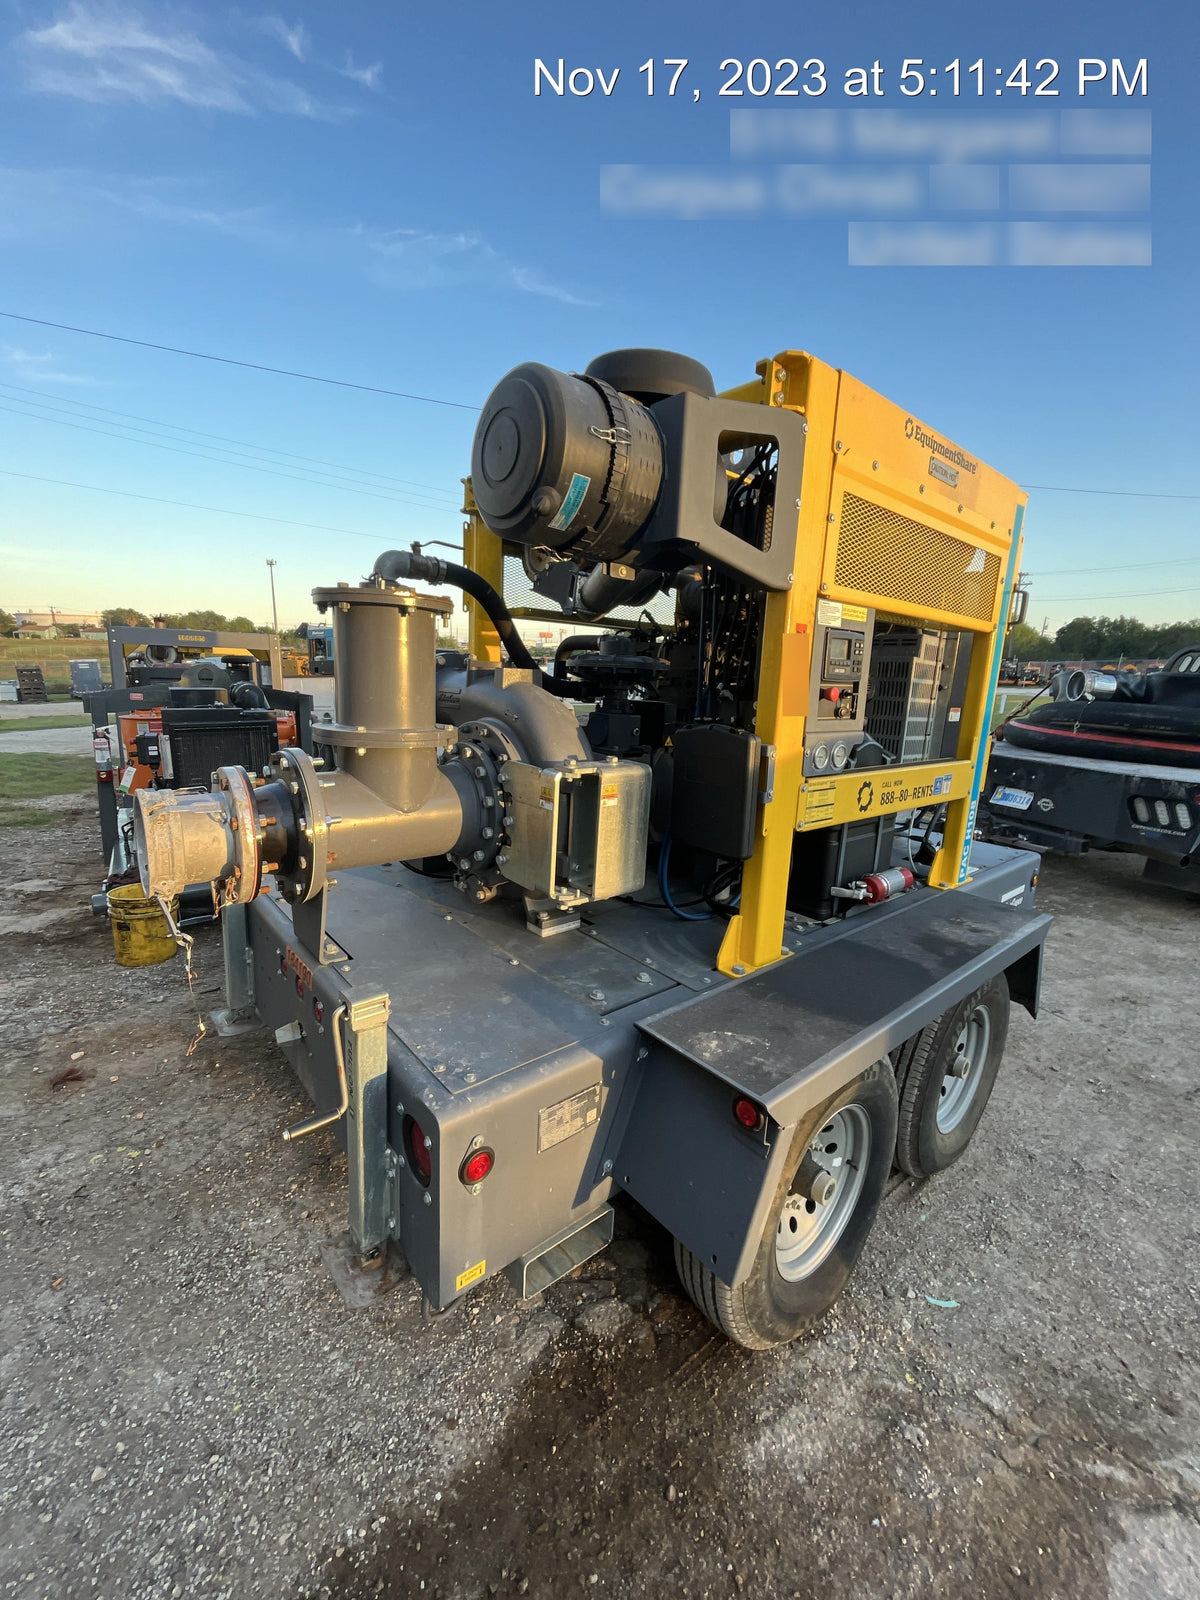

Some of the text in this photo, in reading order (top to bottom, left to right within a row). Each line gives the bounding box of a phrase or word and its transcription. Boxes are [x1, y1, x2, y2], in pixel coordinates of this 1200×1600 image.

[914, 425, 977, 474] EquipmentShare
[880, 784, 933, 805] 888-80-RENTS
[959, 800, 977, 878] PAC H108
